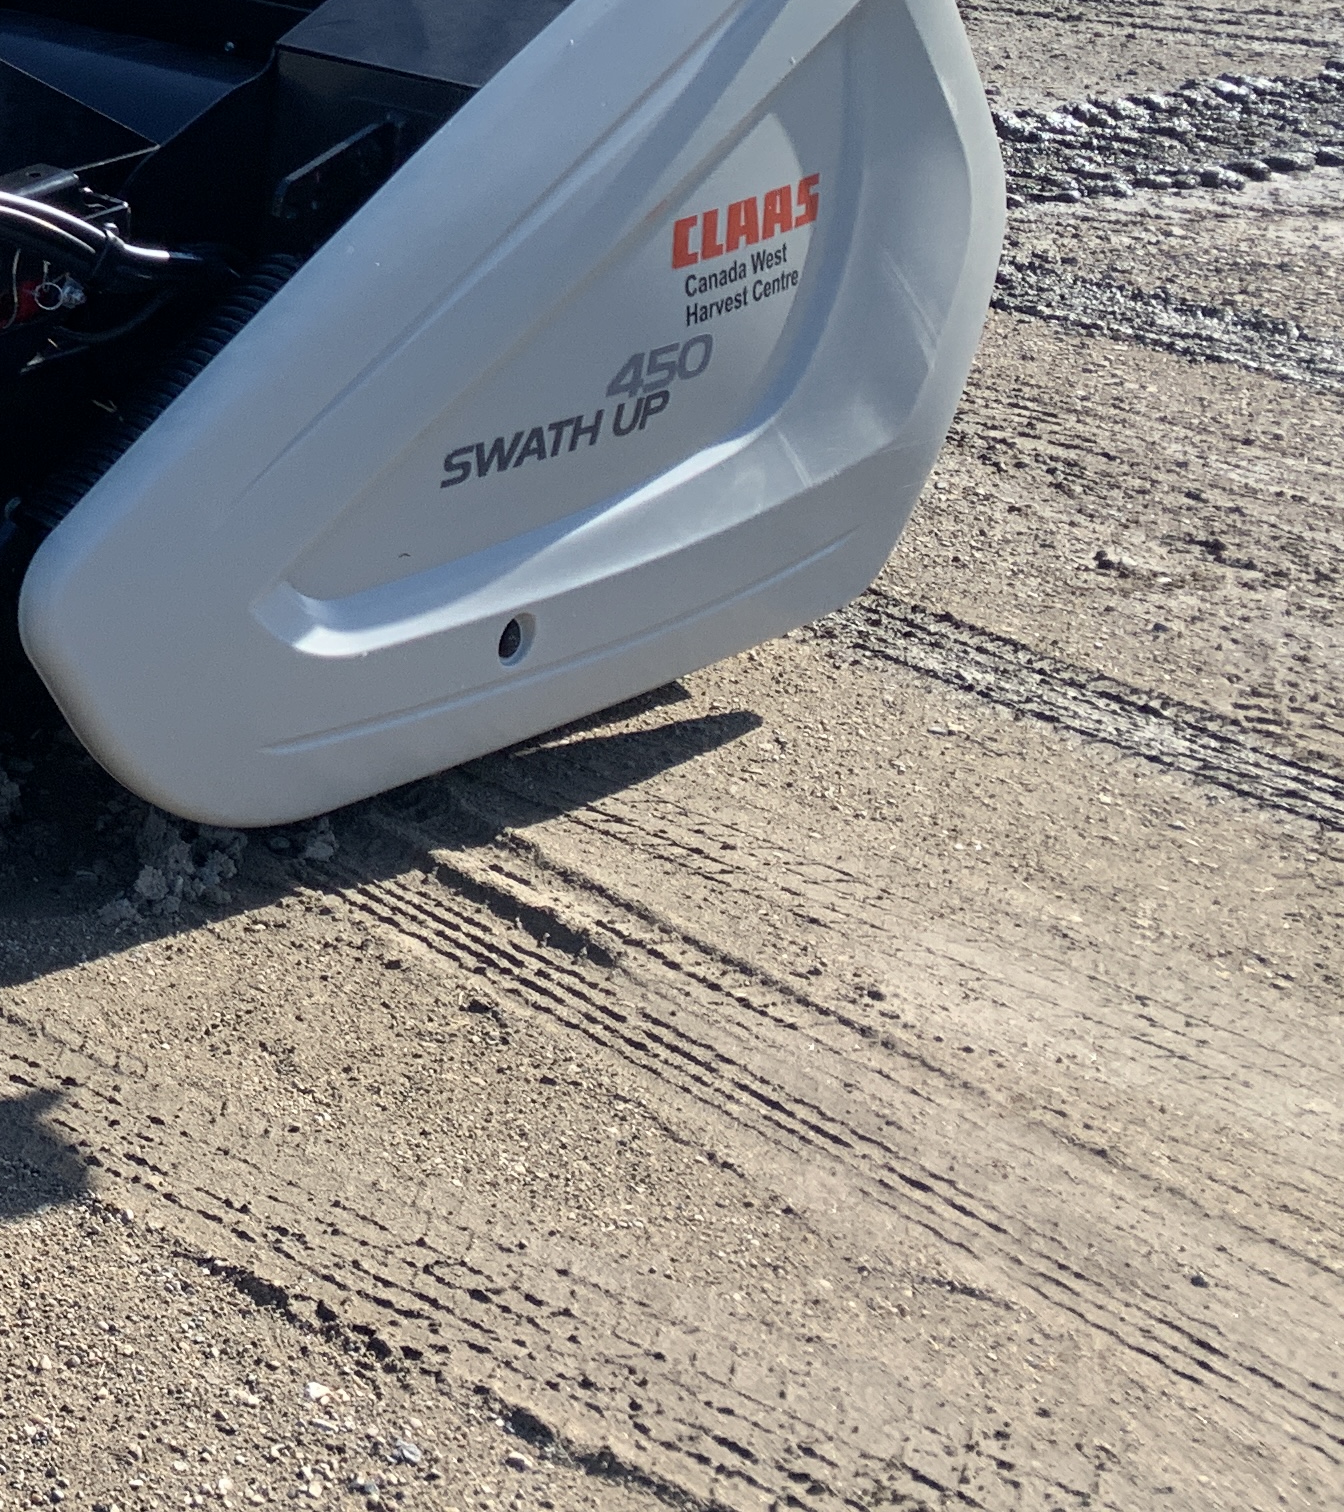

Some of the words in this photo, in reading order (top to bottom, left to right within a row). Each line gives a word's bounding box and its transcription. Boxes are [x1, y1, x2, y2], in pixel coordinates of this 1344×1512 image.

[672, 172, 820, 270] CLAAS
[685, 259, 747, 298] Canada
[751, 242, 788, 275] West
[686, 287, 748, 327] Harvest
[752, 269, 800, 303] Centre
[605, 333, 714, 398] 450
[440, 408, 605, 489] SWATH
[612, 390, 671, 437] UP
